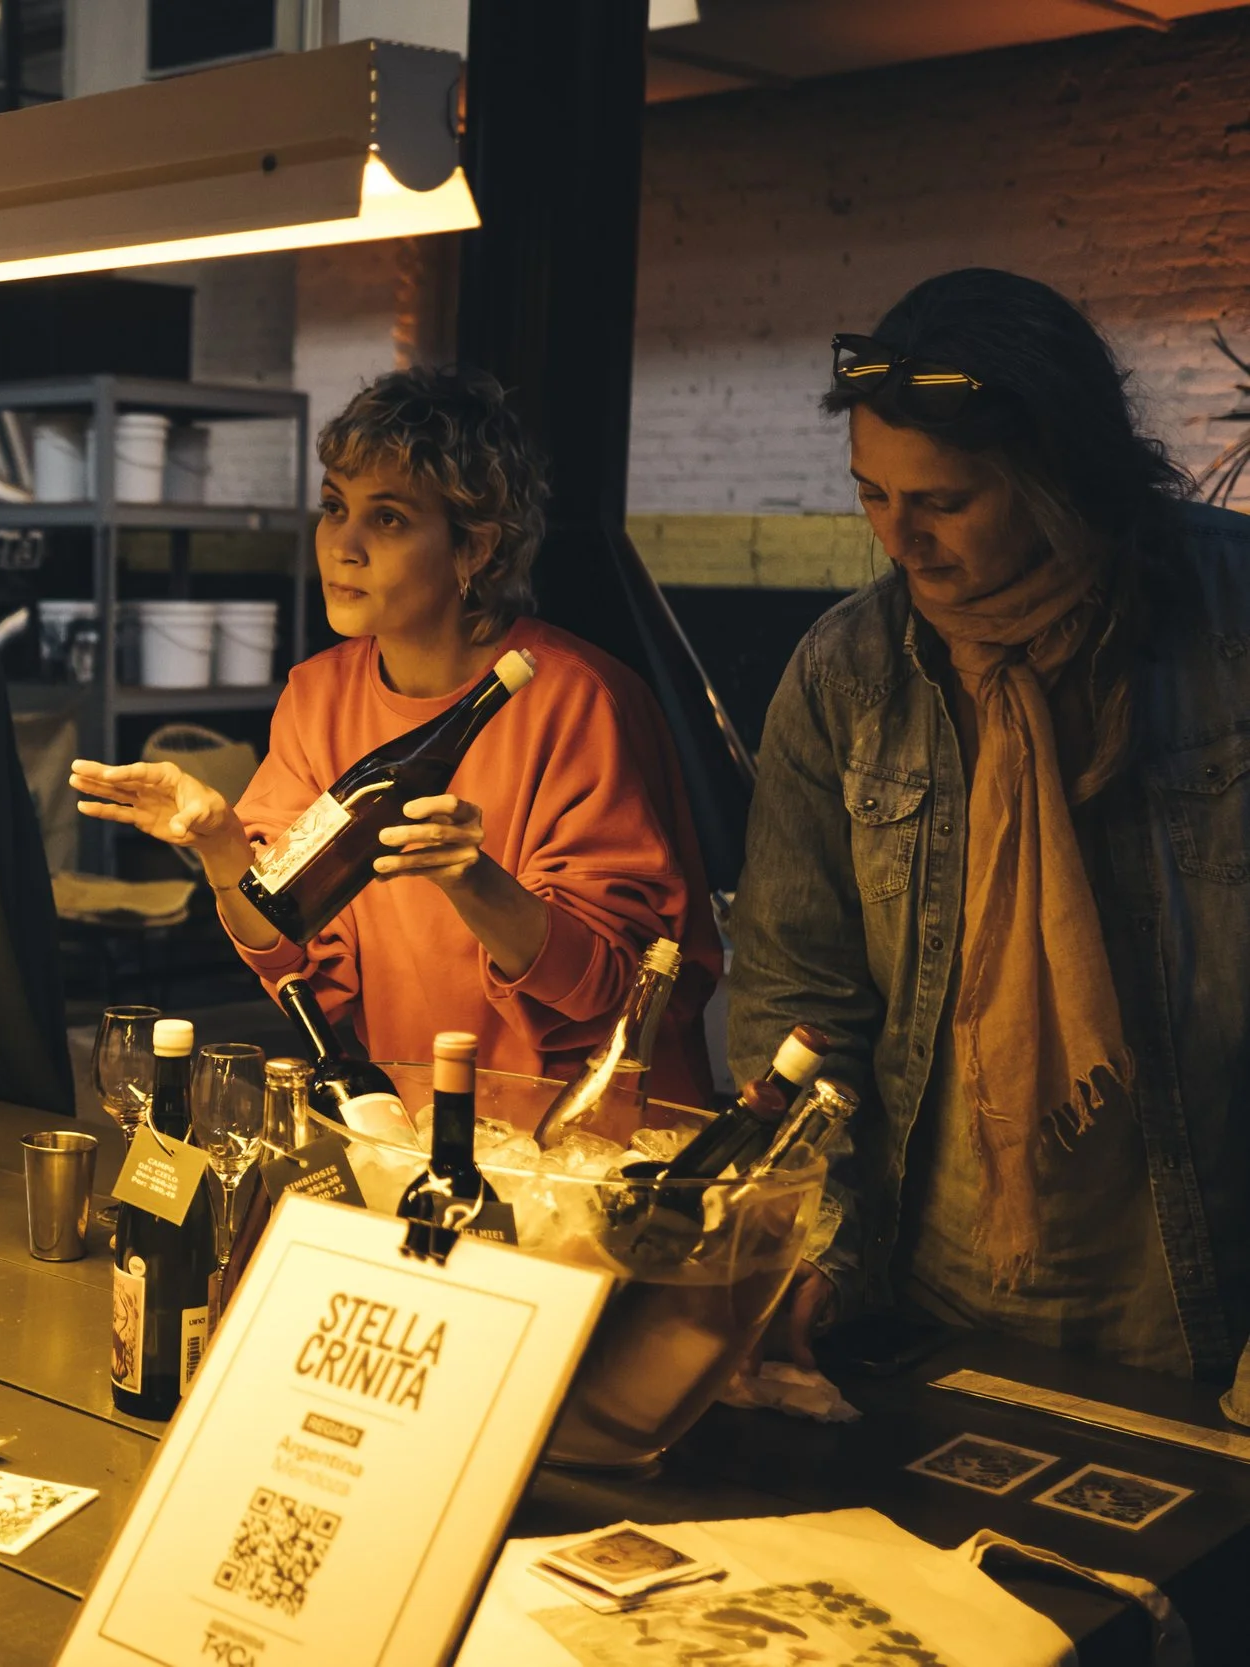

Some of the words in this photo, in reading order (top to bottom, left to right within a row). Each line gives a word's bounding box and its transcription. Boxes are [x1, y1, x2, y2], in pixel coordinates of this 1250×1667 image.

[137, 1162, 153, 1174] DEL
[154, 1169, 179, 1184] CIELO
[147, 1157, 176, 1174] CAMPO
[283, 1164, 338, 1192] SIMBIOSIS
[317, 1183, 347, 1200] 00,22
[479, 1229, 504, 1240] MIEI
[319, 1292, 447, 1366] STELLA
[295, 1332, 428, 1412] CRINITA
[276, 1434, 365, 1478] Argentina
[271, 1455, 352, 1497] Mendoza
